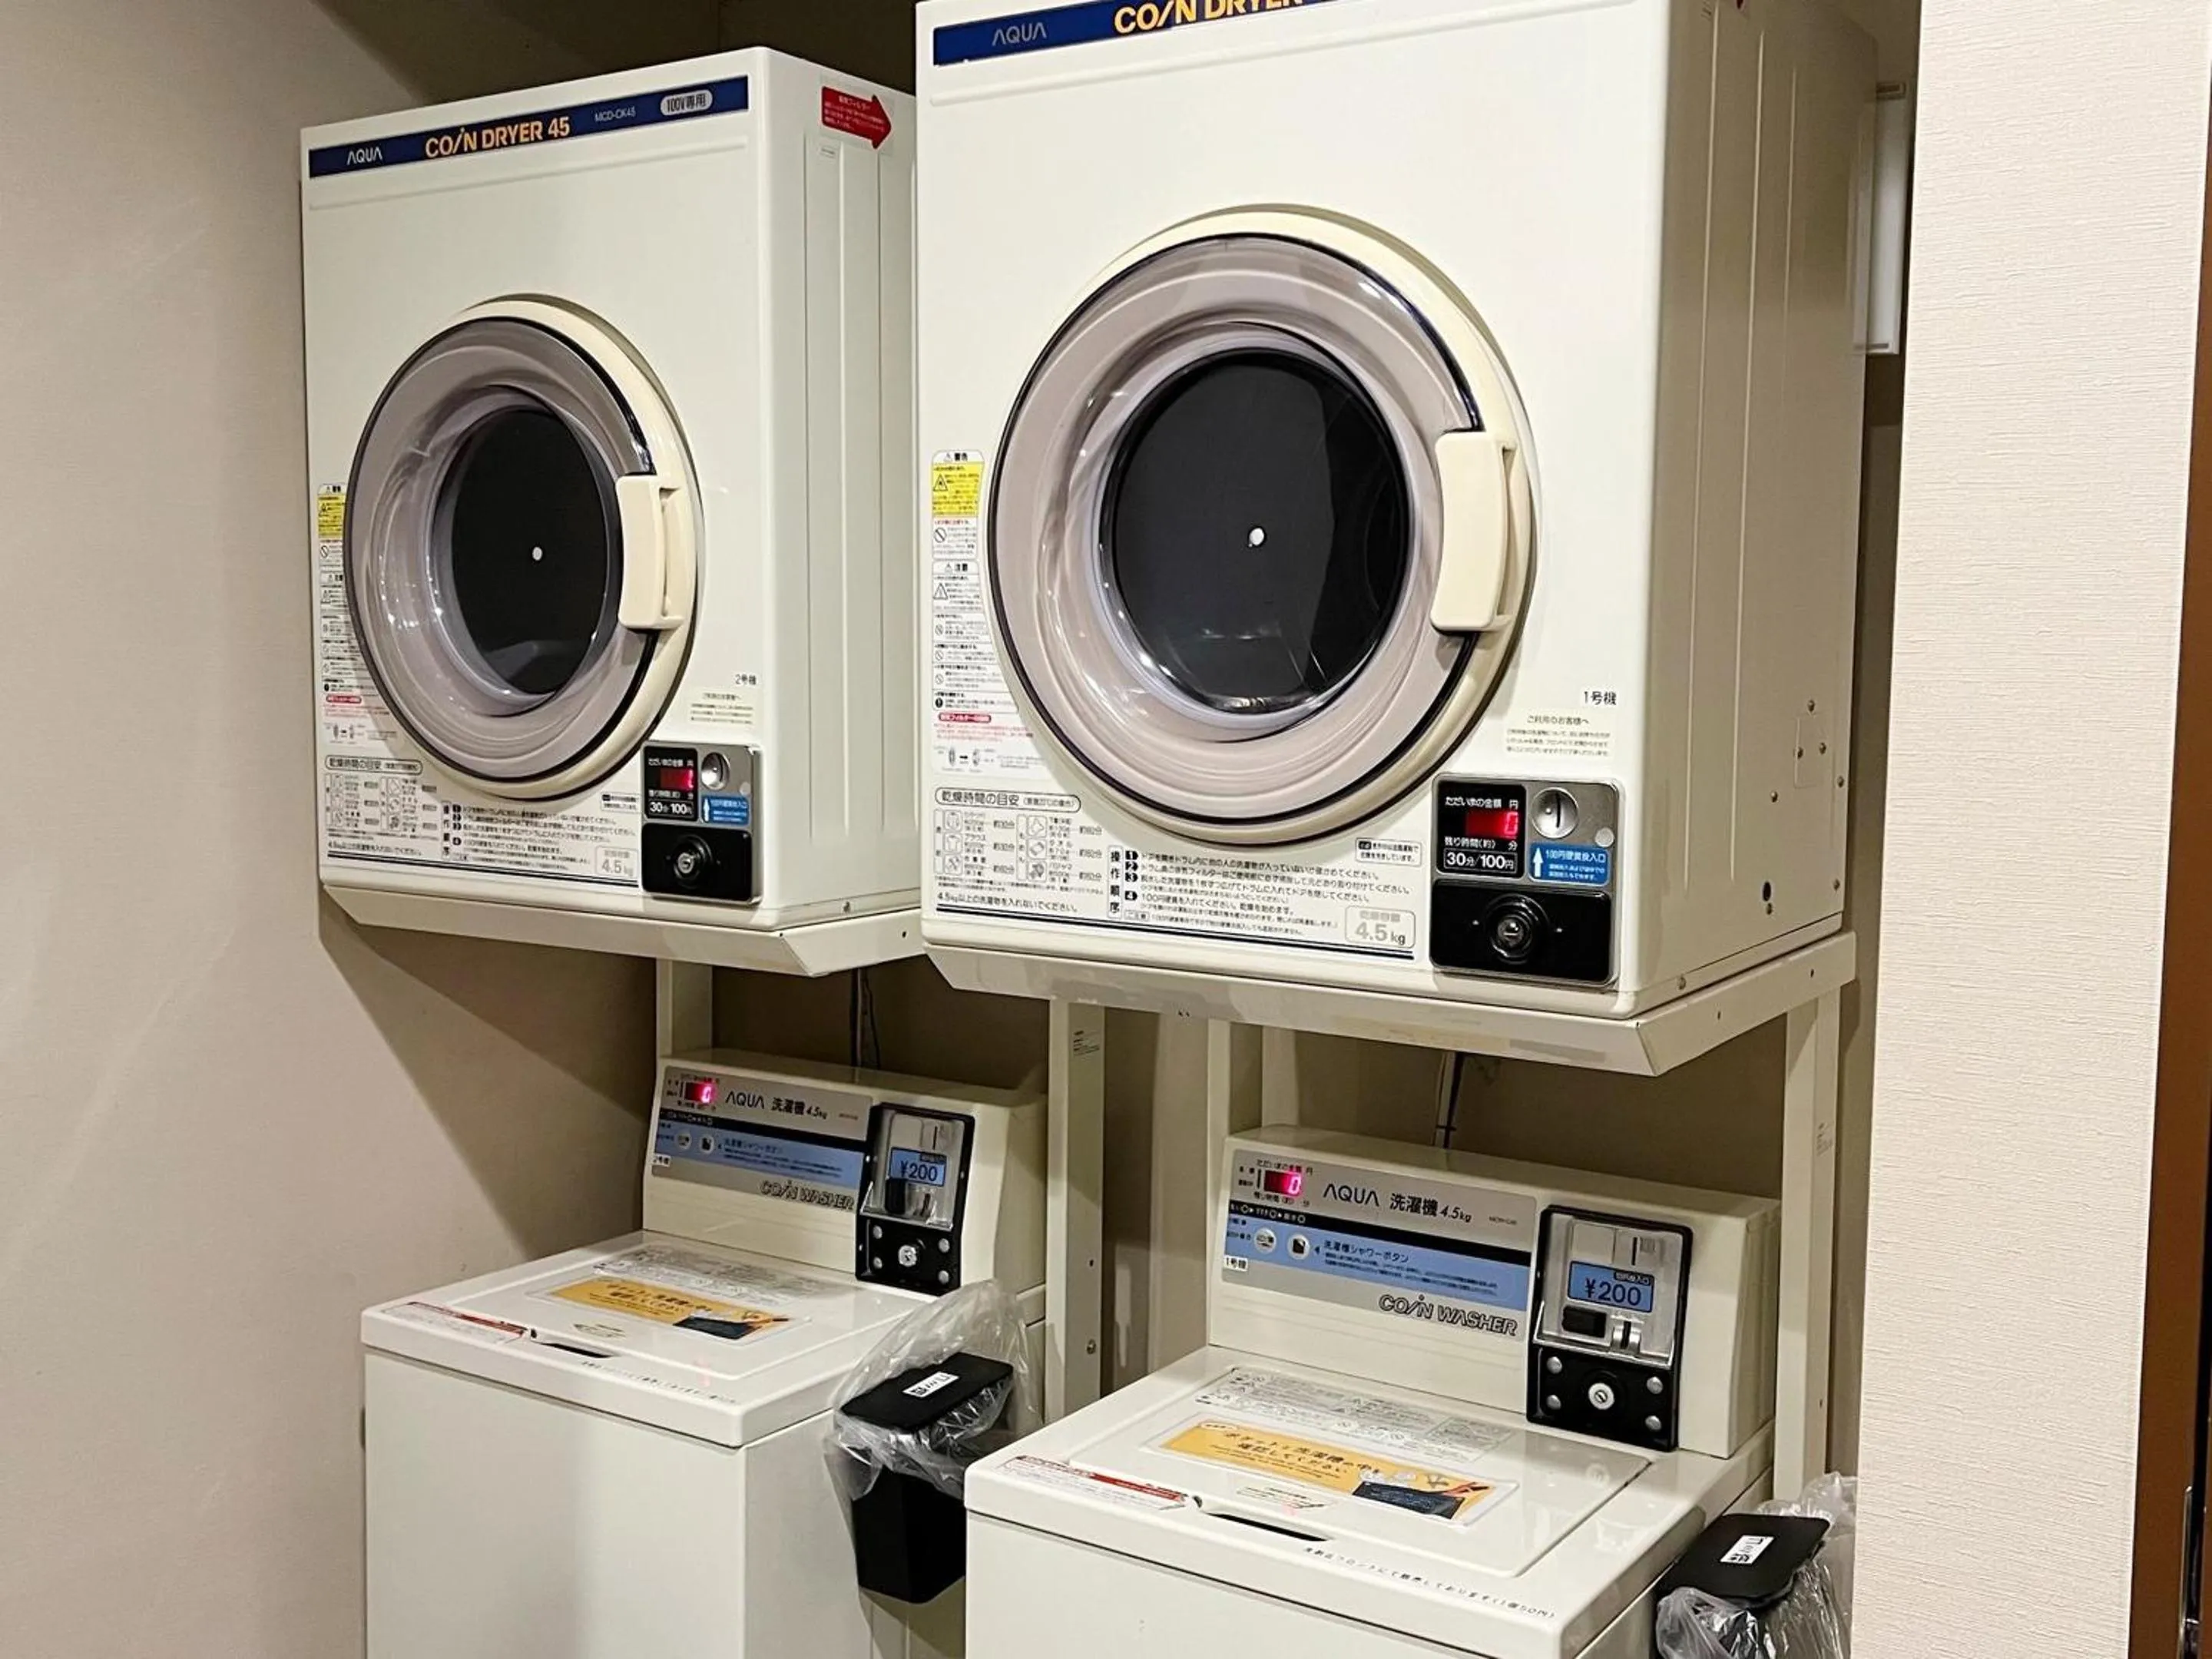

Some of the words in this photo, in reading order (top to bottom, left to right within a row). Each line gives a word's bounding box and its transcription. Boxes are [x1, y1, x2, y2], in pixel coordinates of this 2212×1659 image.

[992, 22, 1047, 47] AQUA
[482, 121, 543, 148] DRYER
[548, 117, 570, 137] 45
[347, 147, 382, 165] AQUA
[1584, 691, 1617, 705] 1号機
[942, 790, 1020, 806] 乾燥時間の目安
[1445, 796, 1502, 808] ただいまの金額
[725, 1091, 765, 1110] AQUA
[771, 1097, 806, 1115] 洗濯機
[900, 1160, 938, 1182] ¥200
[1323, 1183, 1379, 1207] AQUA
[1390, 1193, 1438, 1217] 洗濯機
[1585, 1277, 1641, 1306] ¥200
[1438, 1304, 1518, 1336] WASHER
